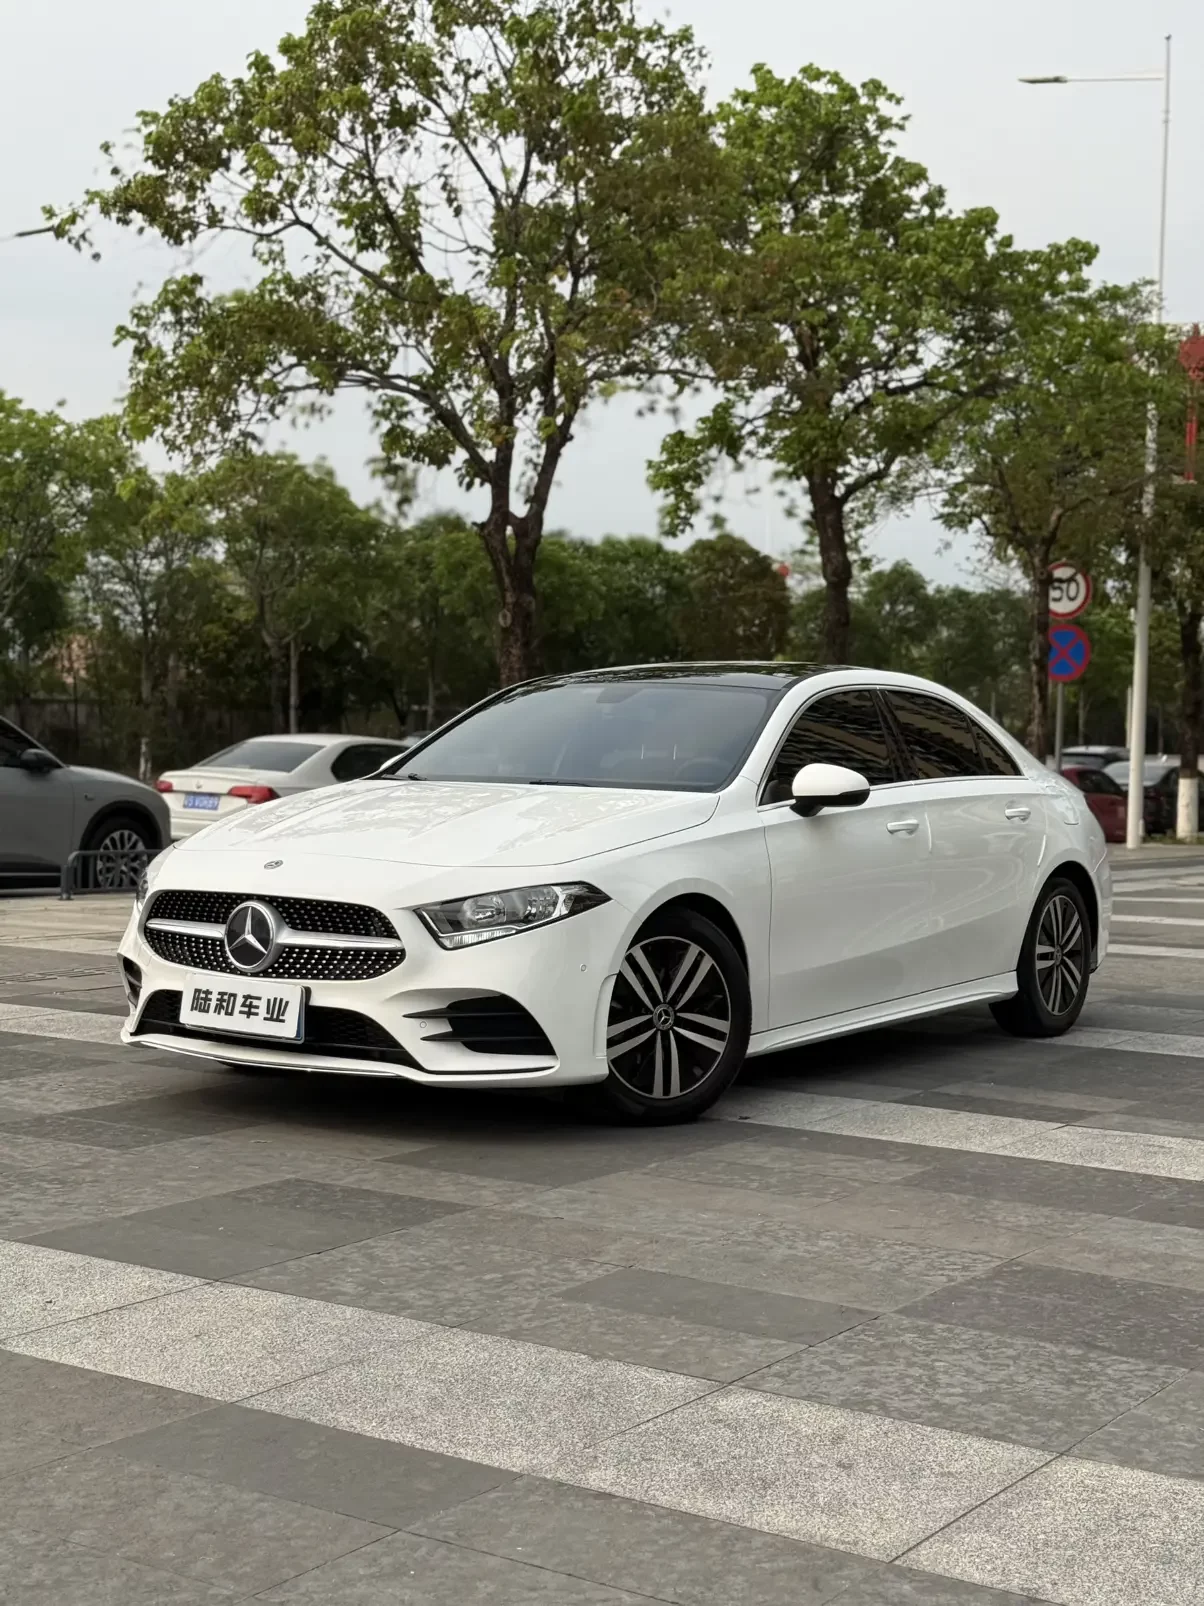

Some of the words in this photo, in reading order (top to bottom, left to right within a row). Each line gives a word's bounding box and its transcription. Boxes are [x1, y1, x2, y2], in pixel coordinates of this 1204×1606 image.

[1050, 578, 1079, 602] 50
[190, 988, 290, 1023] 陆和车业
